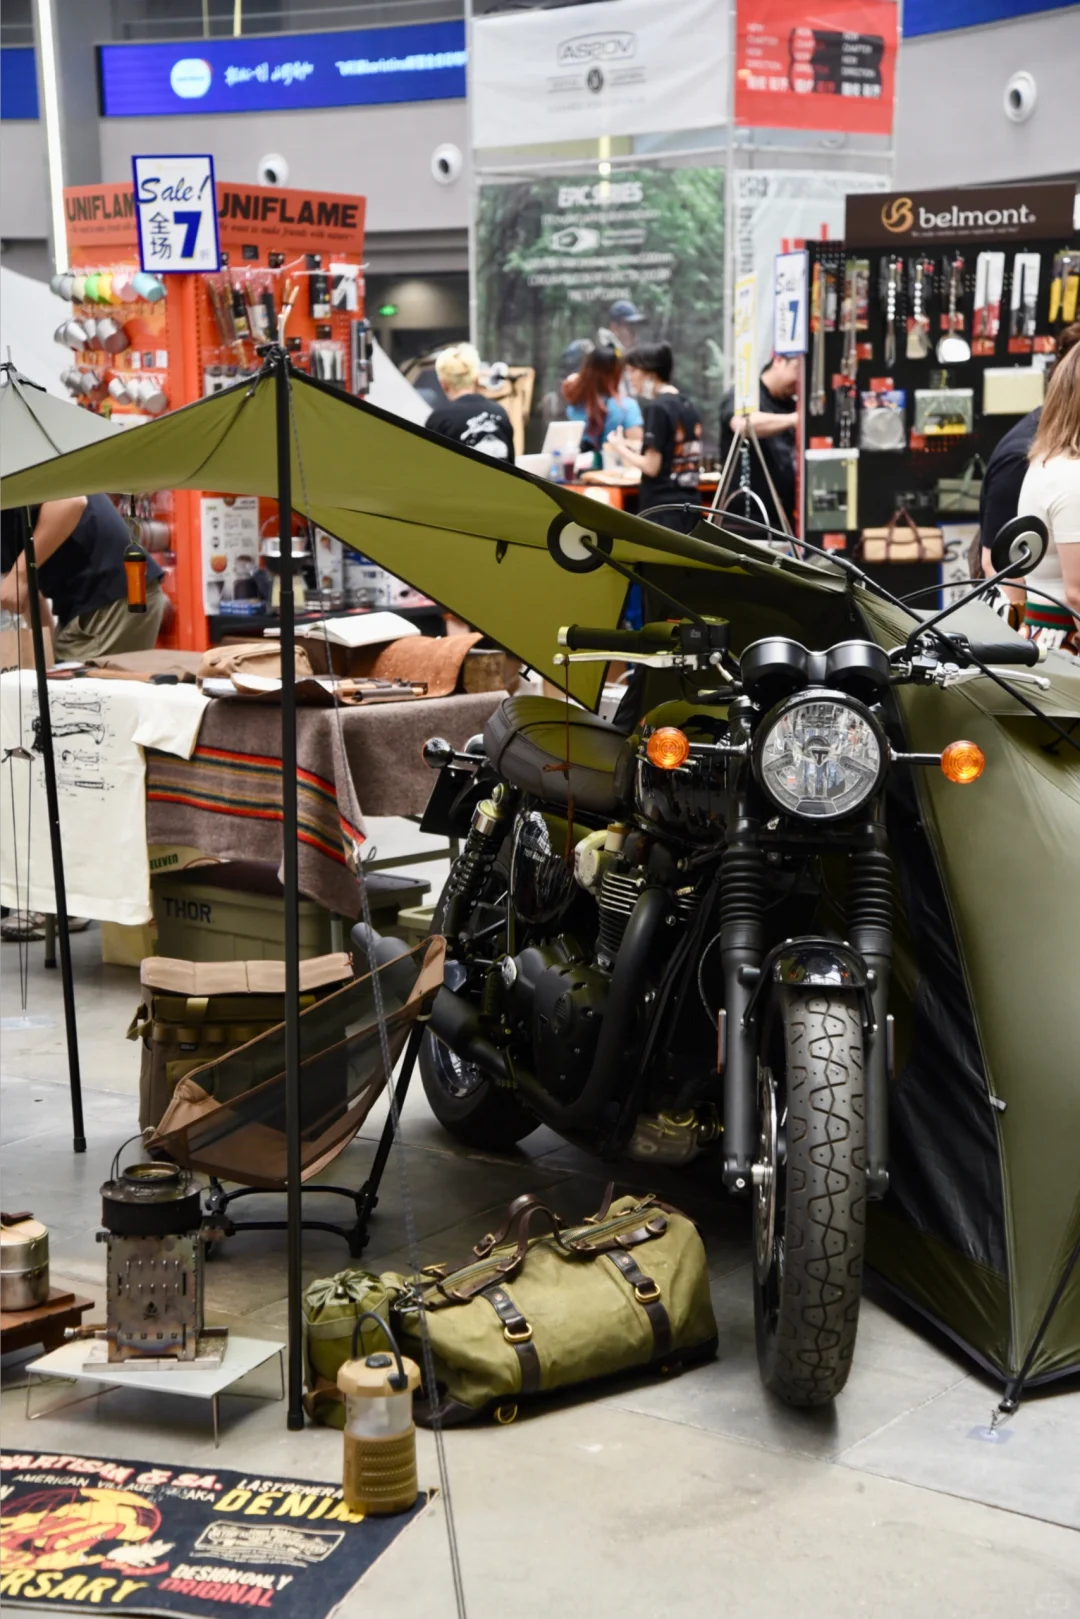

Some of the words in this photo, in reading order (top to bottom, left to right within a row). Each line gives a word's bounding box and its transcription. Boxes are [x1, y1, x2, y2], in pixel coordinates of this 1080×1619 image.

[138, 174, 210, 204] Sale!
[66, 192, 134, 222] UNIFLAM
[173, 211, 202, 258] 7
[162, 897, 212, 924] THOR
[12, 1473, 90, 1488] AMERICAN
[0, 1569, 149, 1603] RSARY
